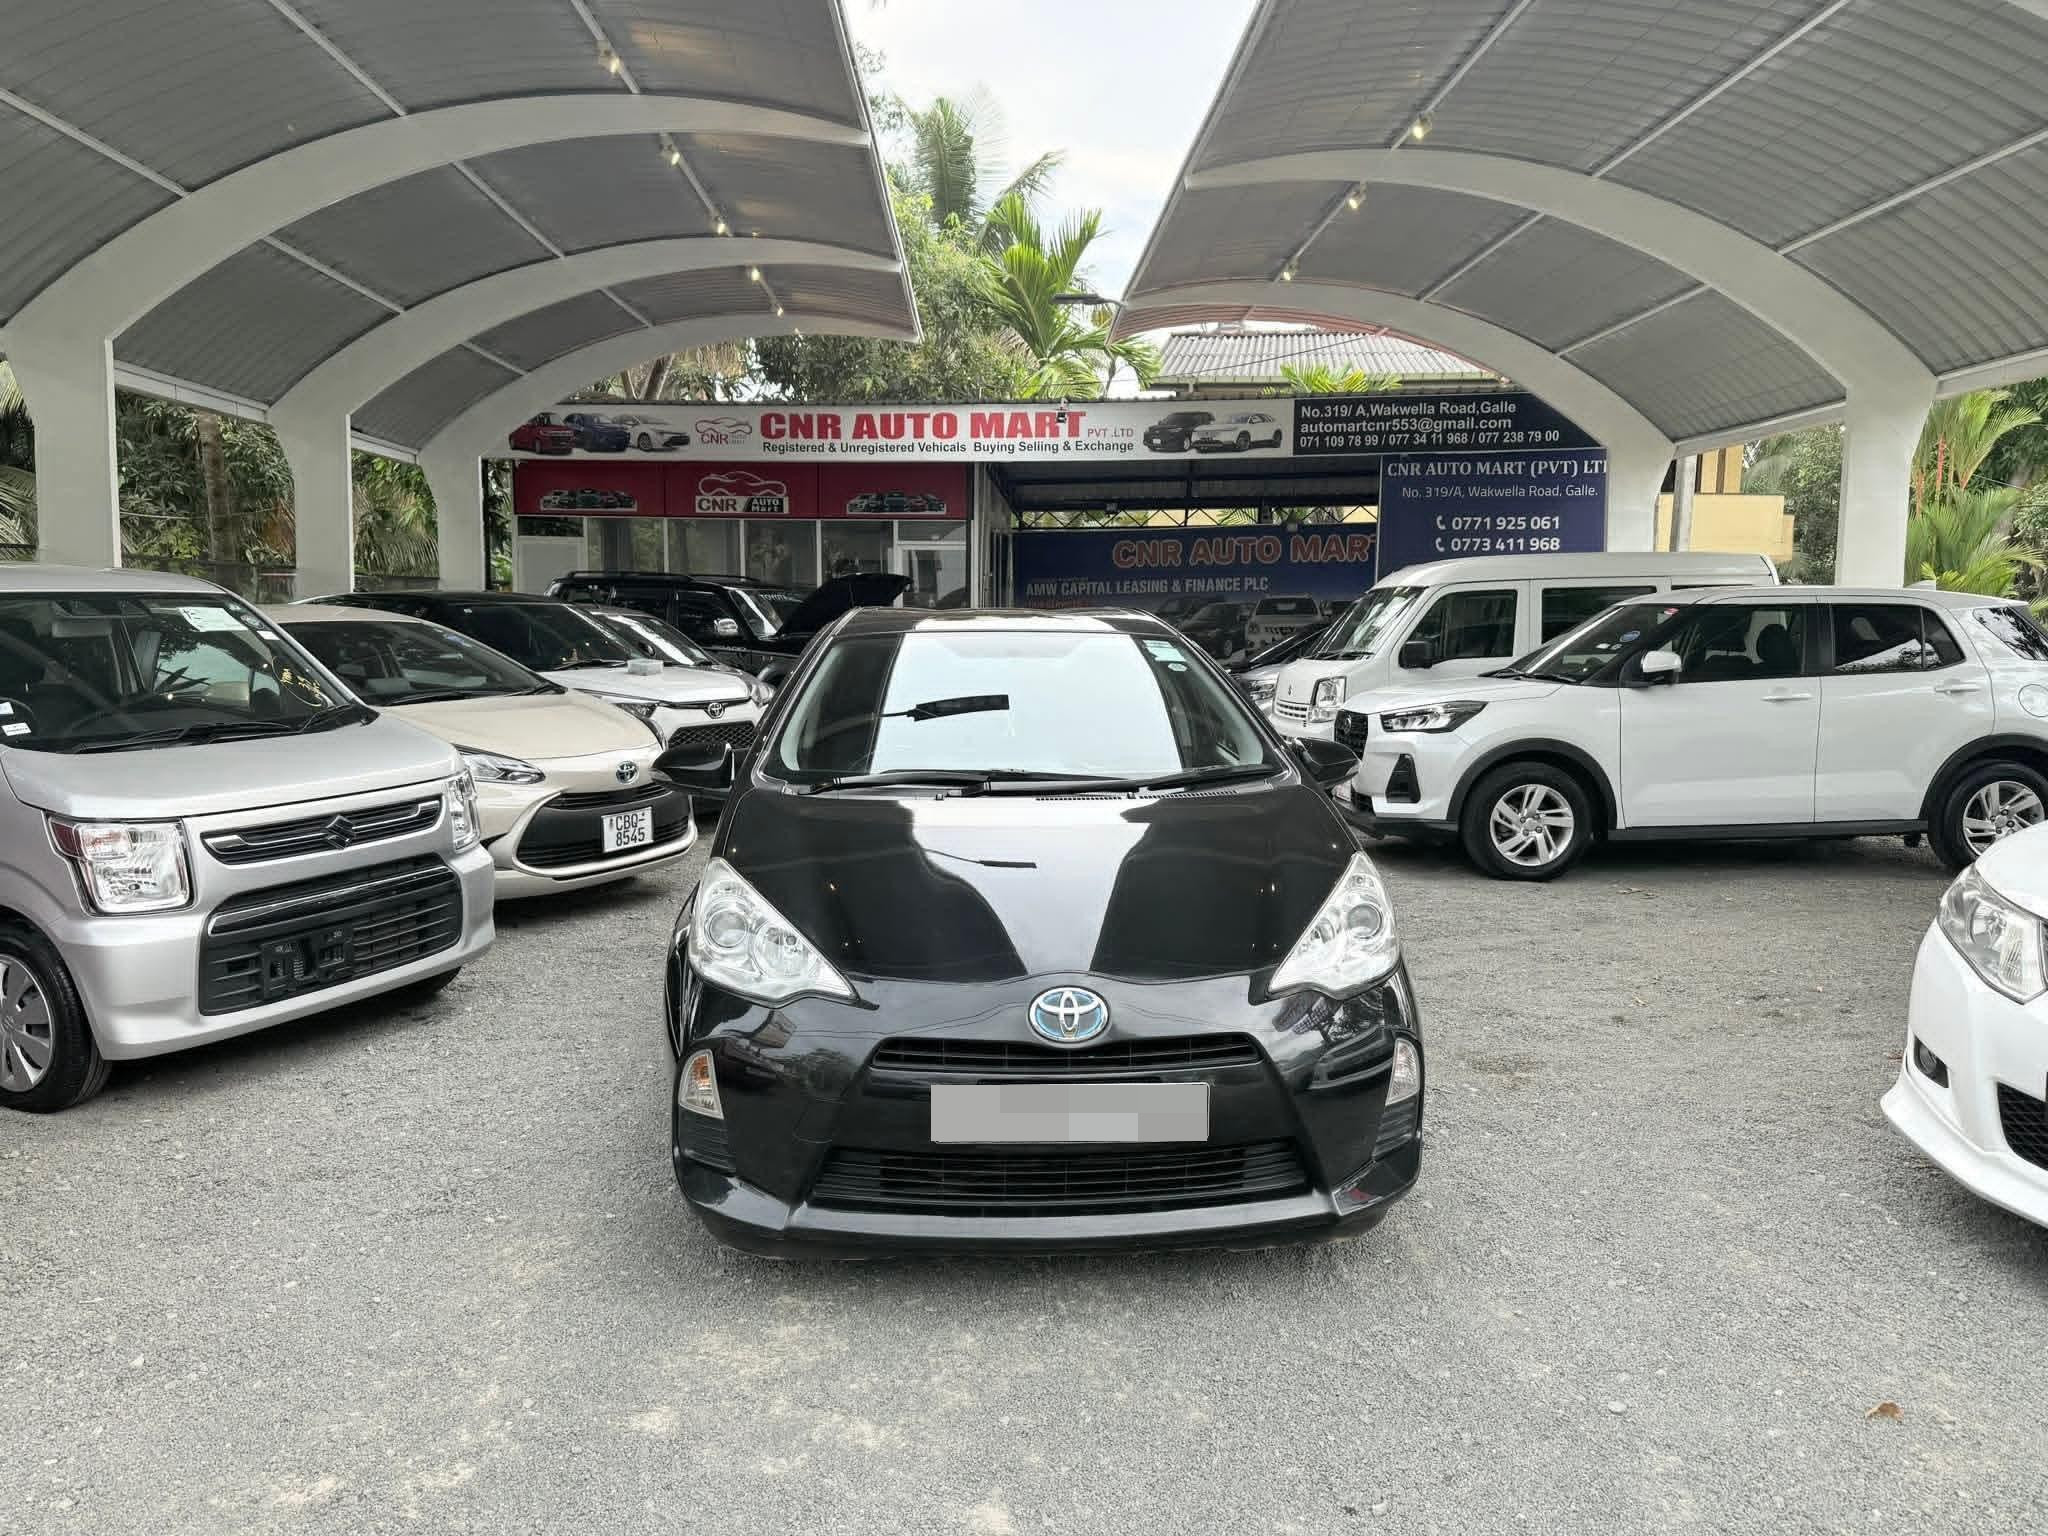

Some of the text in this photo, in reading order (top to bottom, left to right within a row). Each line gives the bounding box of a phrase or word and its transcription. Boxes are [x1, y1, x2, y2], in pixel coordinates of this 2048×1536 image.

[1301, 404, 1353, 418] No.319/
[1440, 400, 1517, 415] Road,Galle
[760, 411, 1086, 439] CNR AUTO MART
[1300, 416, 1512, 433] automartcnr553@gmail.com
[701, 433, 729, 445] CNR
[1088, 428, 1108, 438] PVT
[1300, 435, 1320, 448] 071
[1325, 435, 1344, 447] 109
[1348, 434, 1361, 447] 78
[1365, 434, 1378, 446] 99
[1389, 433, 1409, 446] 077
[1413, 433, 1427, 445] 34
[1431, 432, 1442, 444] 11
[1447, 432, 1468, 444] 968
[1478, 431, 1499, 444] 077
[1503, 431, 1524, 443] 238
[1528, 430, 1541, 443] 79
[1545, 430, 1559, 442] 00
[763, 440, 1134, 455] Registered & Unregistered Vehicals Buying Selling & Exchange
[1387, 463, 1421, 476] CNR
[1425, 462, 1471, 475] AUTO
[1476, 461, 1526, 475] MART
[1530, 460, 1578, 478] (PVT)
[1468, 484, 1525, 497] Wakwella
[1565, 484, 1599, 497] Galle.
[698, 497, 737, 512] CNR
[752, 497, 779, 505] AUTO
[1452, 515, 1560, 530] 0771 925 061
[1112, 539, 1183, 568] CNR
[1189, 536, 1282, 566] AUTO
[1450, 537, 1560, 551] 0773 411 968
[1026, 576, 1269, 596] AMW CAPITAL LEASING & FINANCE PLC
[616, 827, 645, 847] 8545
